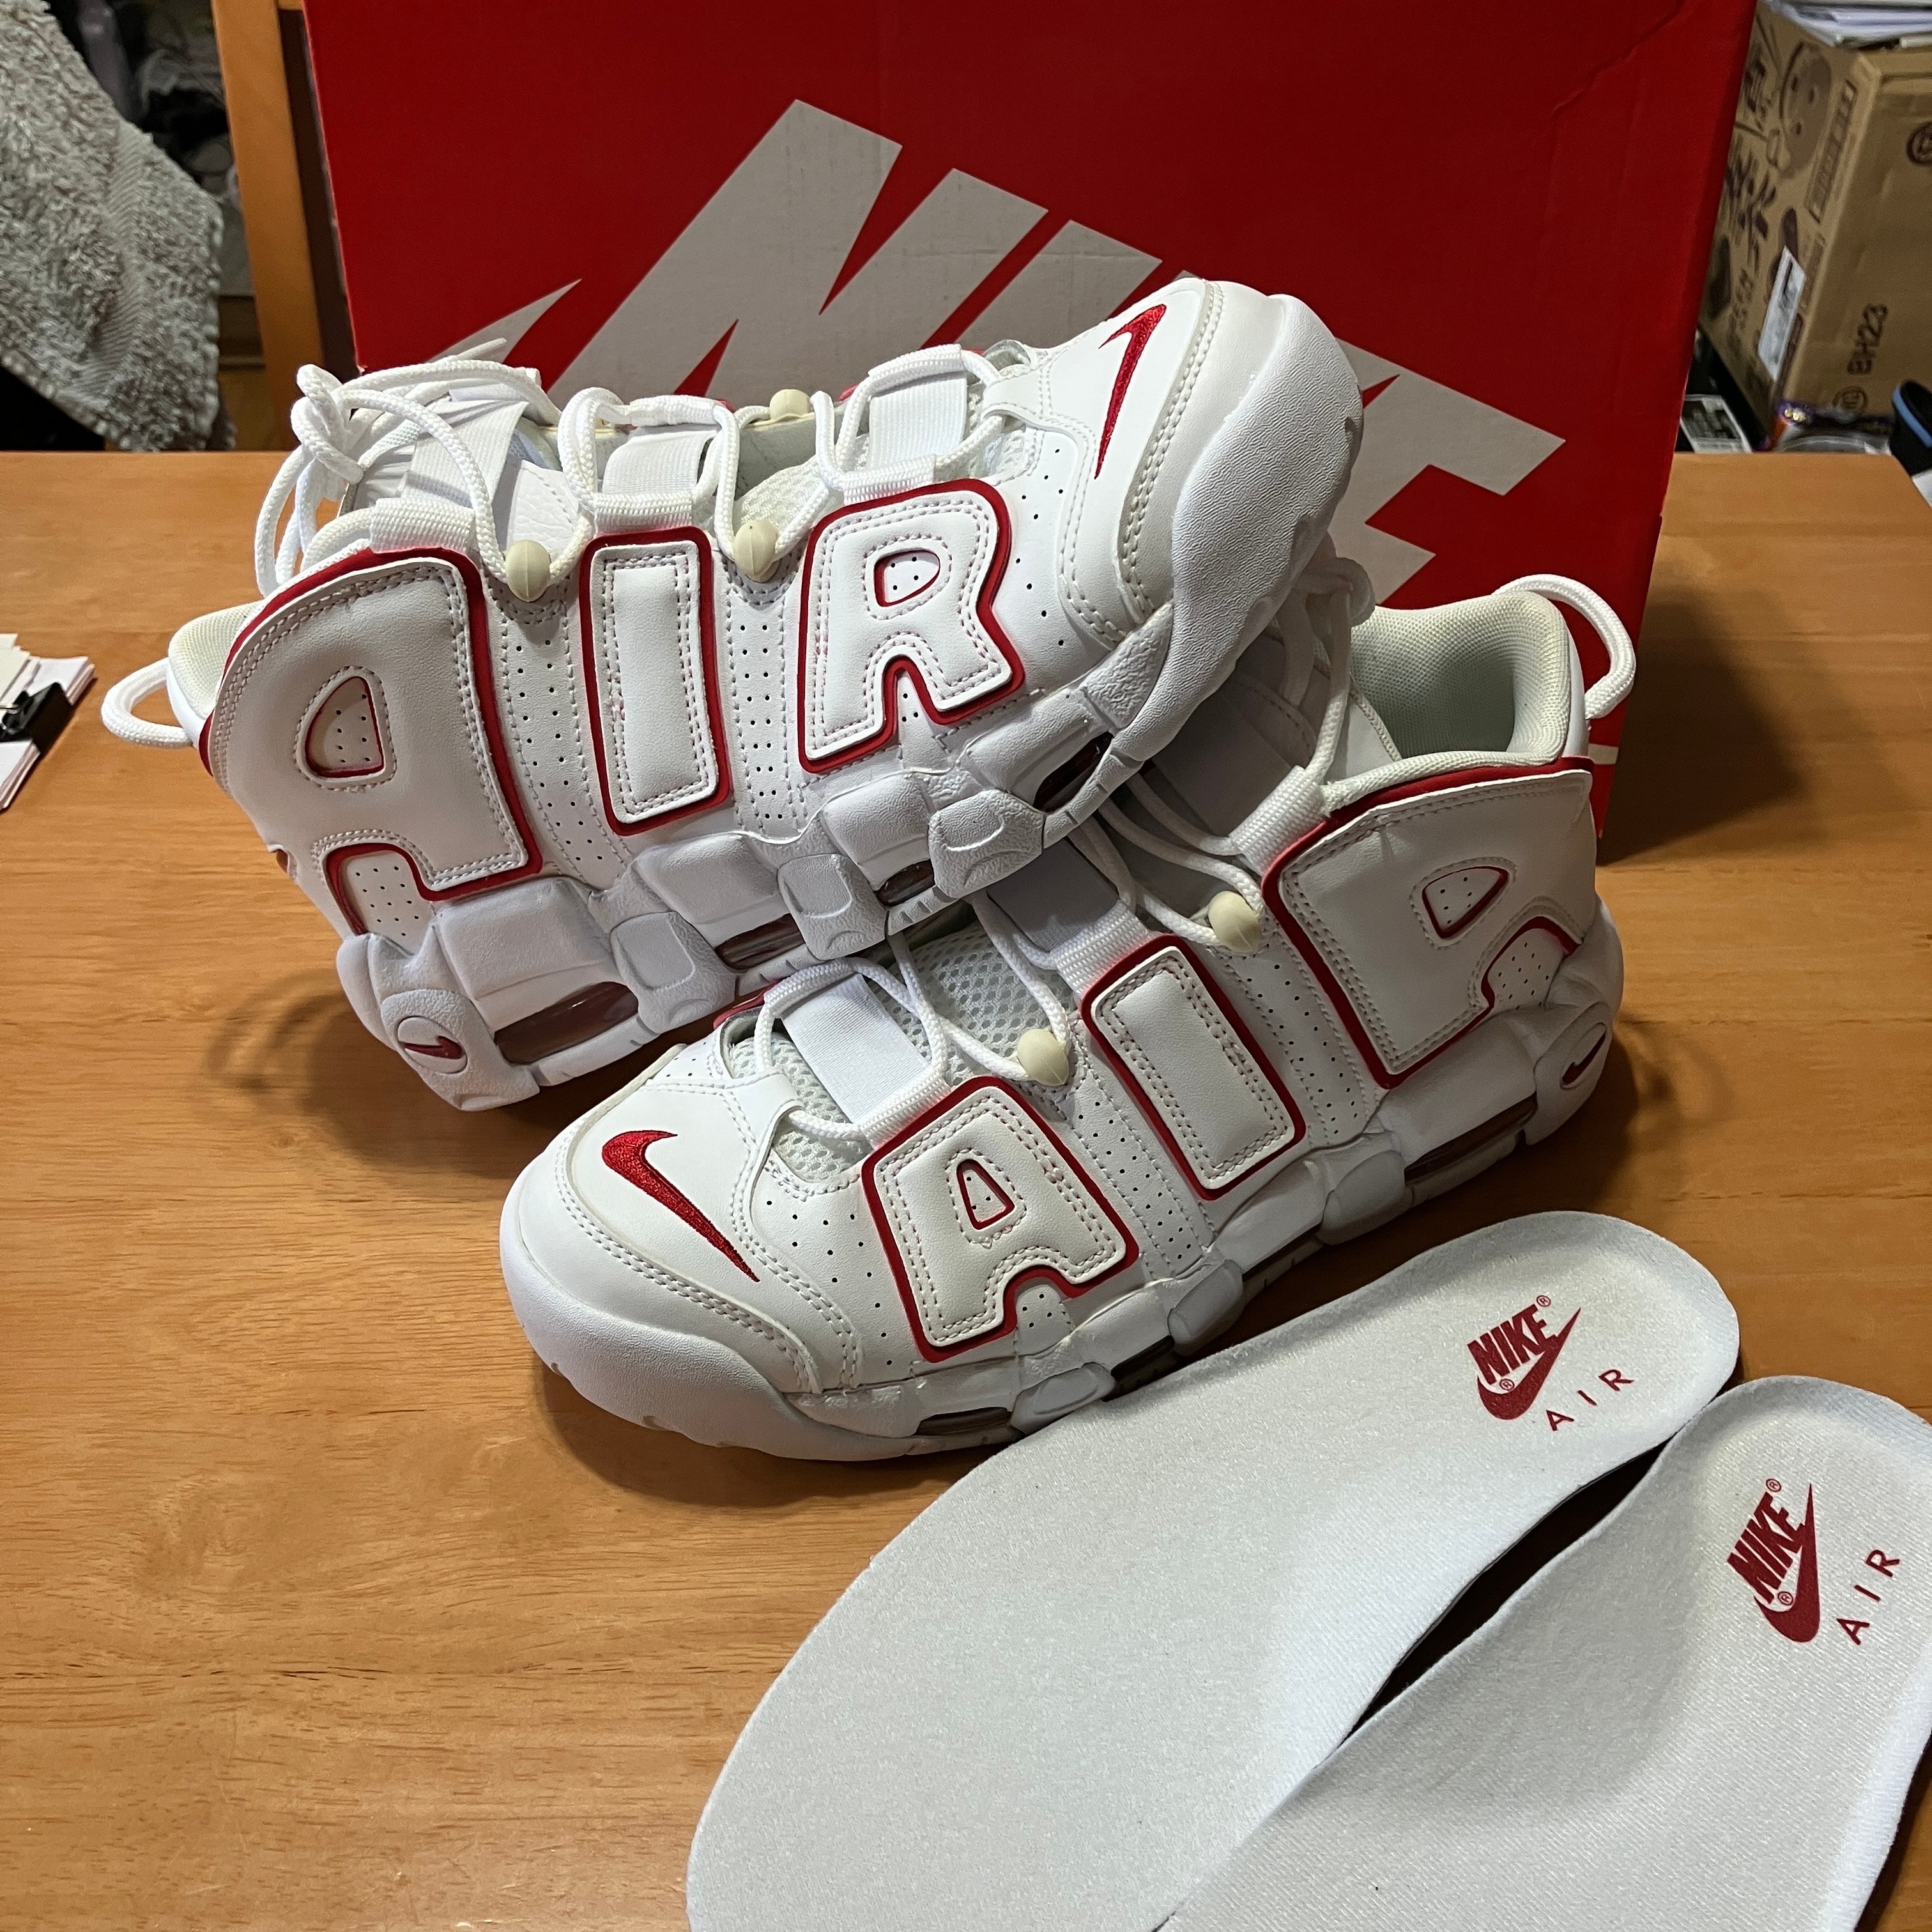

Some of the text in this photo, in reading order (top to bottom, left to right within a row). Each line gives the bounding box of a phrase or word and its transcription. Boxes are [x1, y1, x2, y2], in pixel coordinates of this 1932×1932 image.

[537, 100, 1567, 604] NE
[200, 478, 1025, 934] AIR
[1466, 1303, 1558, 1385] NIKE
[1545, 1368, 1634, 1432] AIR
[1727, 1491, 1806, 1604] NIKE
[1836, 1548, 1901, 1646] AIR
